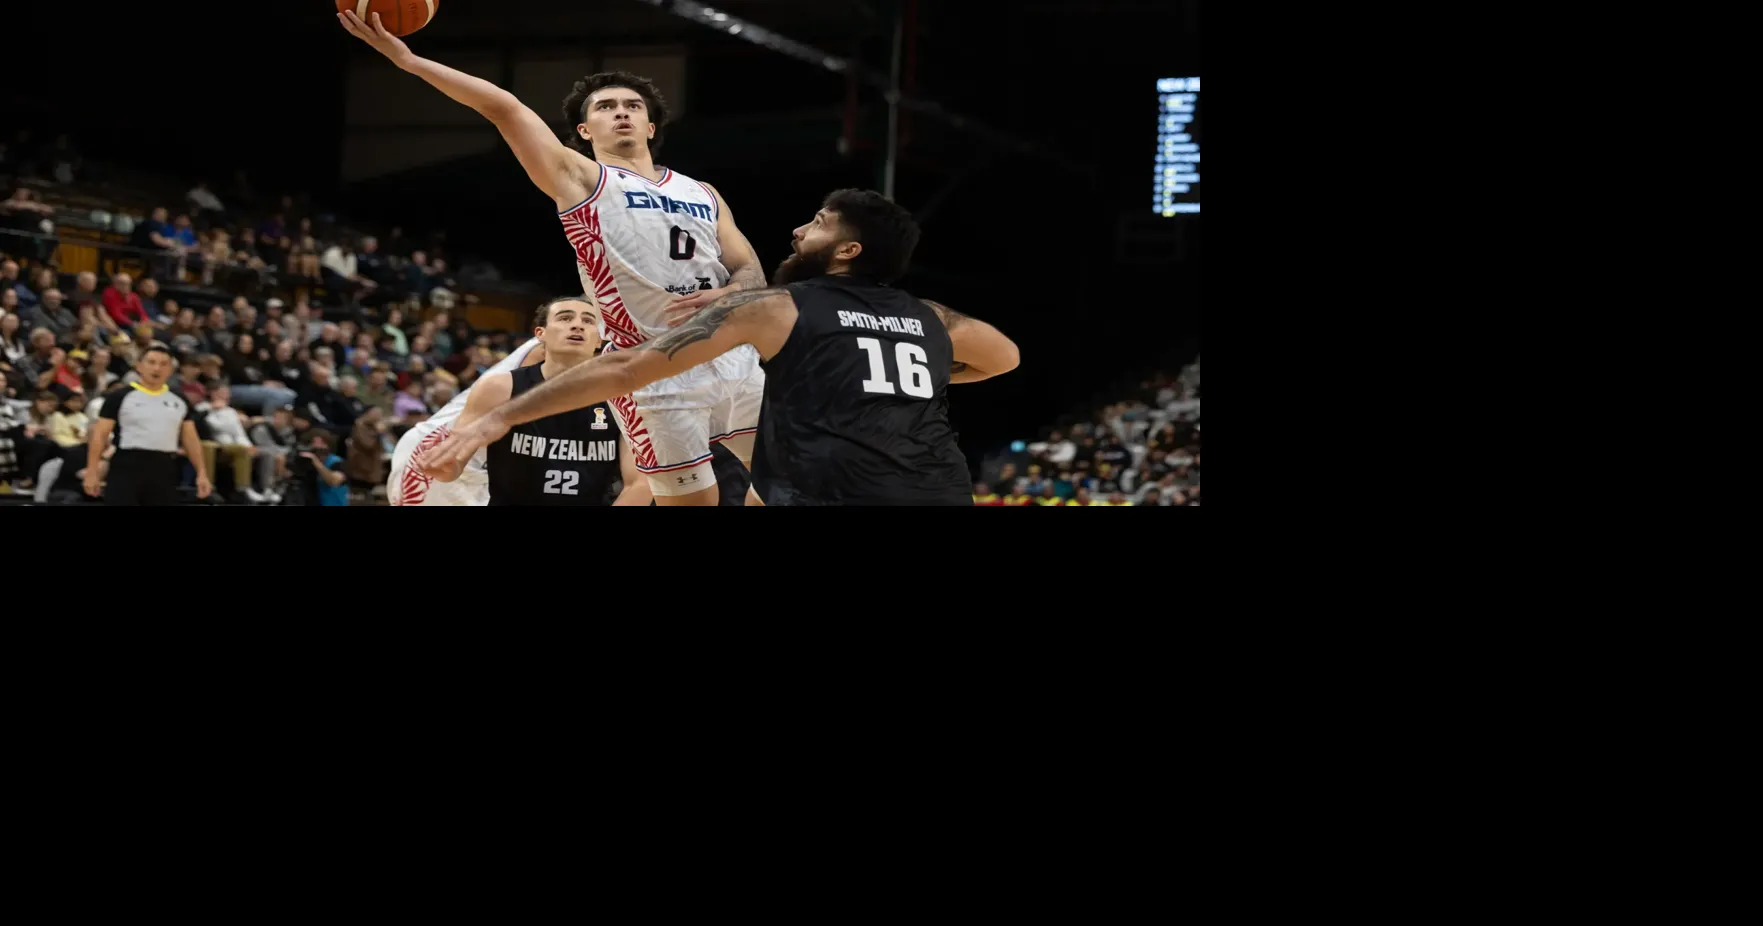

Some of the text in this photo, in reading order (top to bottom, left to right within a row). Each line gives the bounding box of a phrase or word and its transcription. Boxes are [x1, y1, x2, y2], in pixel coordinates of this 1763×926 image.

[623, 191, 713, 222] GUAM
[669, 225, 696, 260] 0
[668, 284, 687, 292] Bank
[837, 310, 925, 337] SMITH-MILNER
[856, 337, 934, 399] 16
[511, 432, 616, 462] NEW ZEALAND
[543, 469, 579, 495] 22
